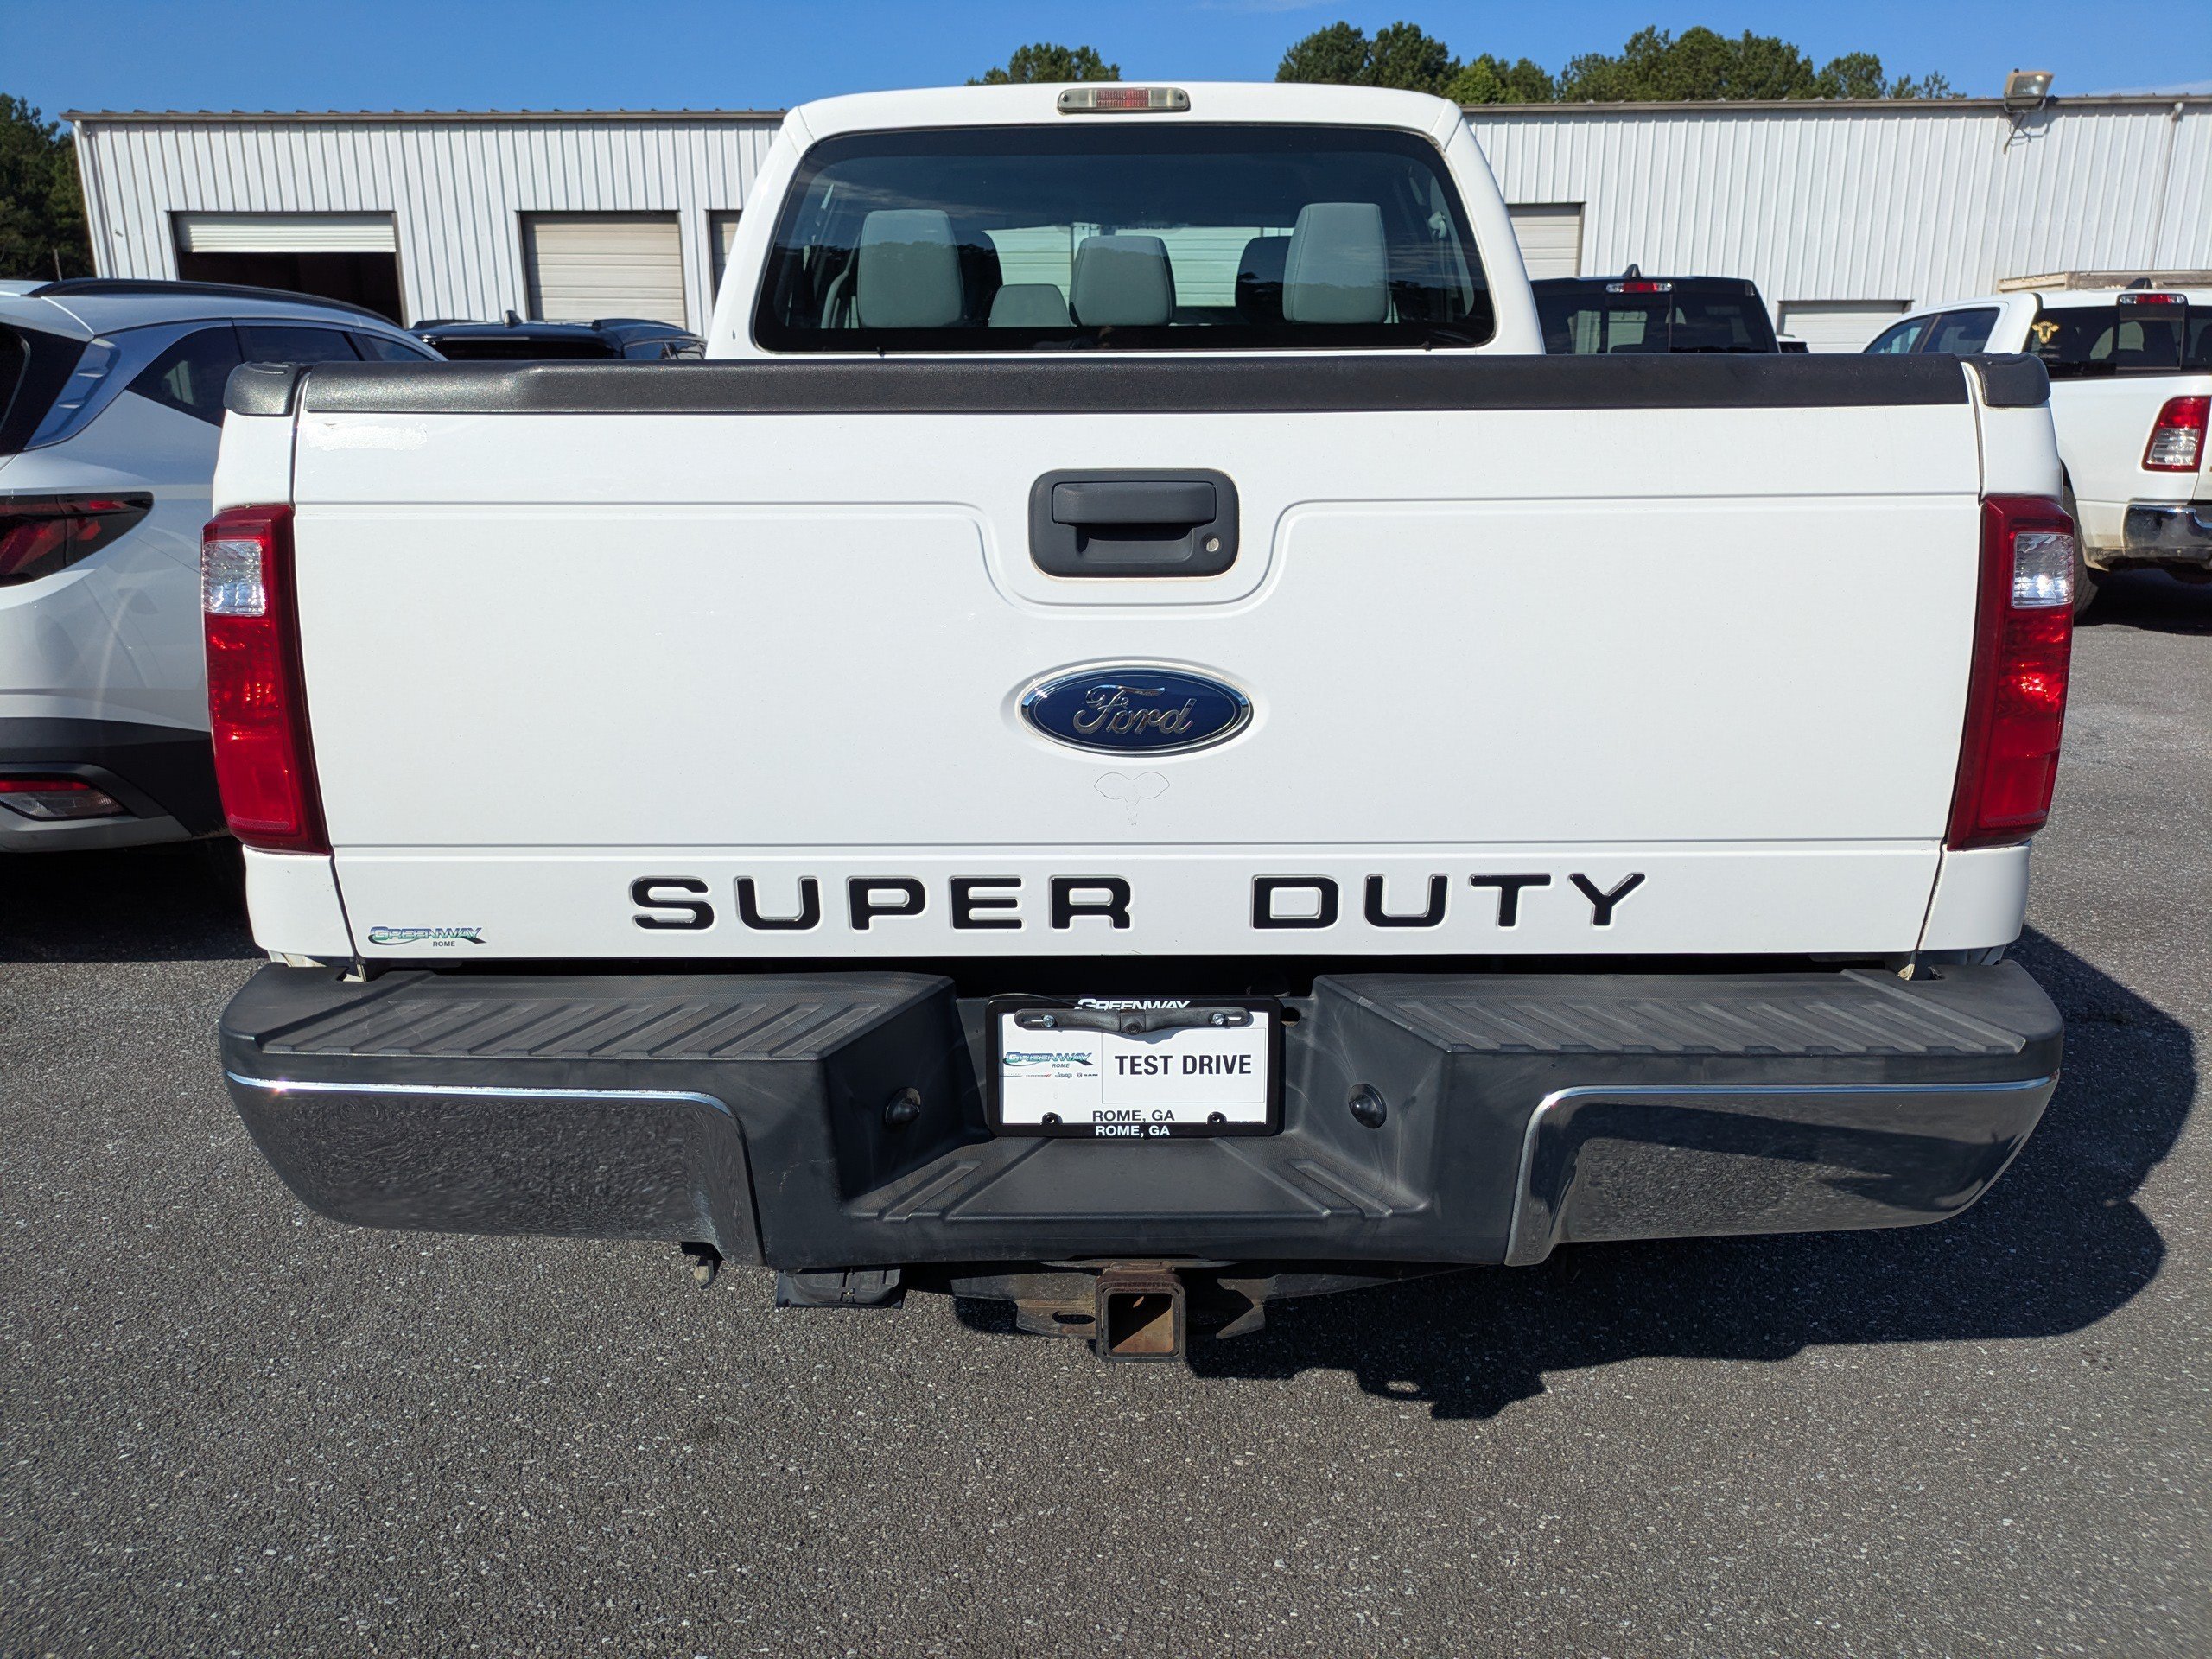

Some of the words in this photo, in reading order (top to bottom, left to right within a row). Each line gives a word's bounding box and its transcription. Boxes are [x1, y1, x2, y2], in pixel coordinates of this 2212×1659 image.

[1073, 684, 1198, 734] Ford
[629, 875, 1132, 931] SUPER
[1251, 873, 1647, 931] DUTY
[370, 926, 482, 941] GREENWAY
[1005, 1051, 1092, 1063] GREENWAY
[1115, 1055, 1173, 1075] TEST
[1182, 1054, 1252, 1075] DRIVE
[1092, 1109, 1146, 1122] ROME,
[1152, 1109, 1175, 1122] GA
[1095, 1125, 1144, 1138] ROME,
[1148, 1124, 1171, 1136] GA
